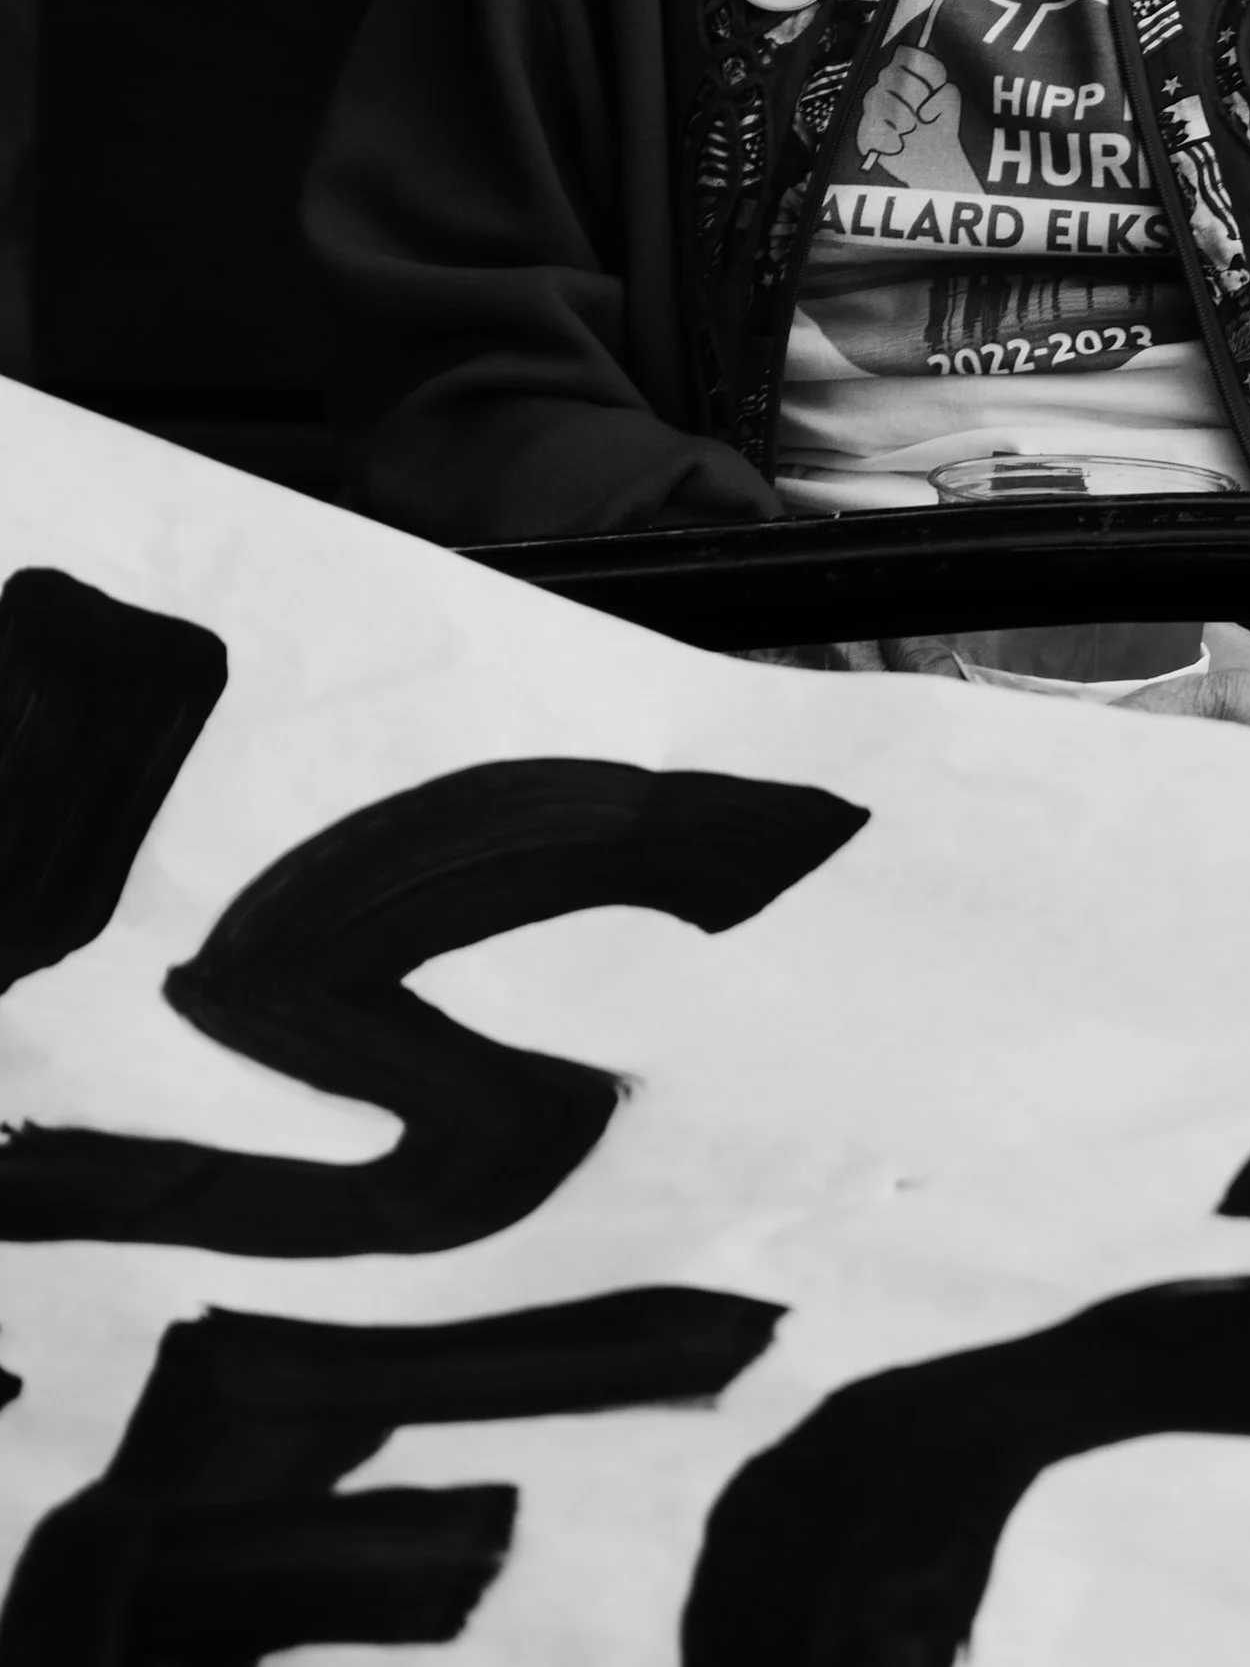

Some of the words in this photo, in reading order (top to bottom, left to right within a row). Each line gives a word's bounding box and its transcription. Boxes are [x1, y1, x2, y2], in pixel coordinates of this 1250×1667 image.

[992, 75, 1106, 121] HIPP
[1046, 208, 1178, 255] ELKS
[926, 324, 1154, 376] 2022-2023
